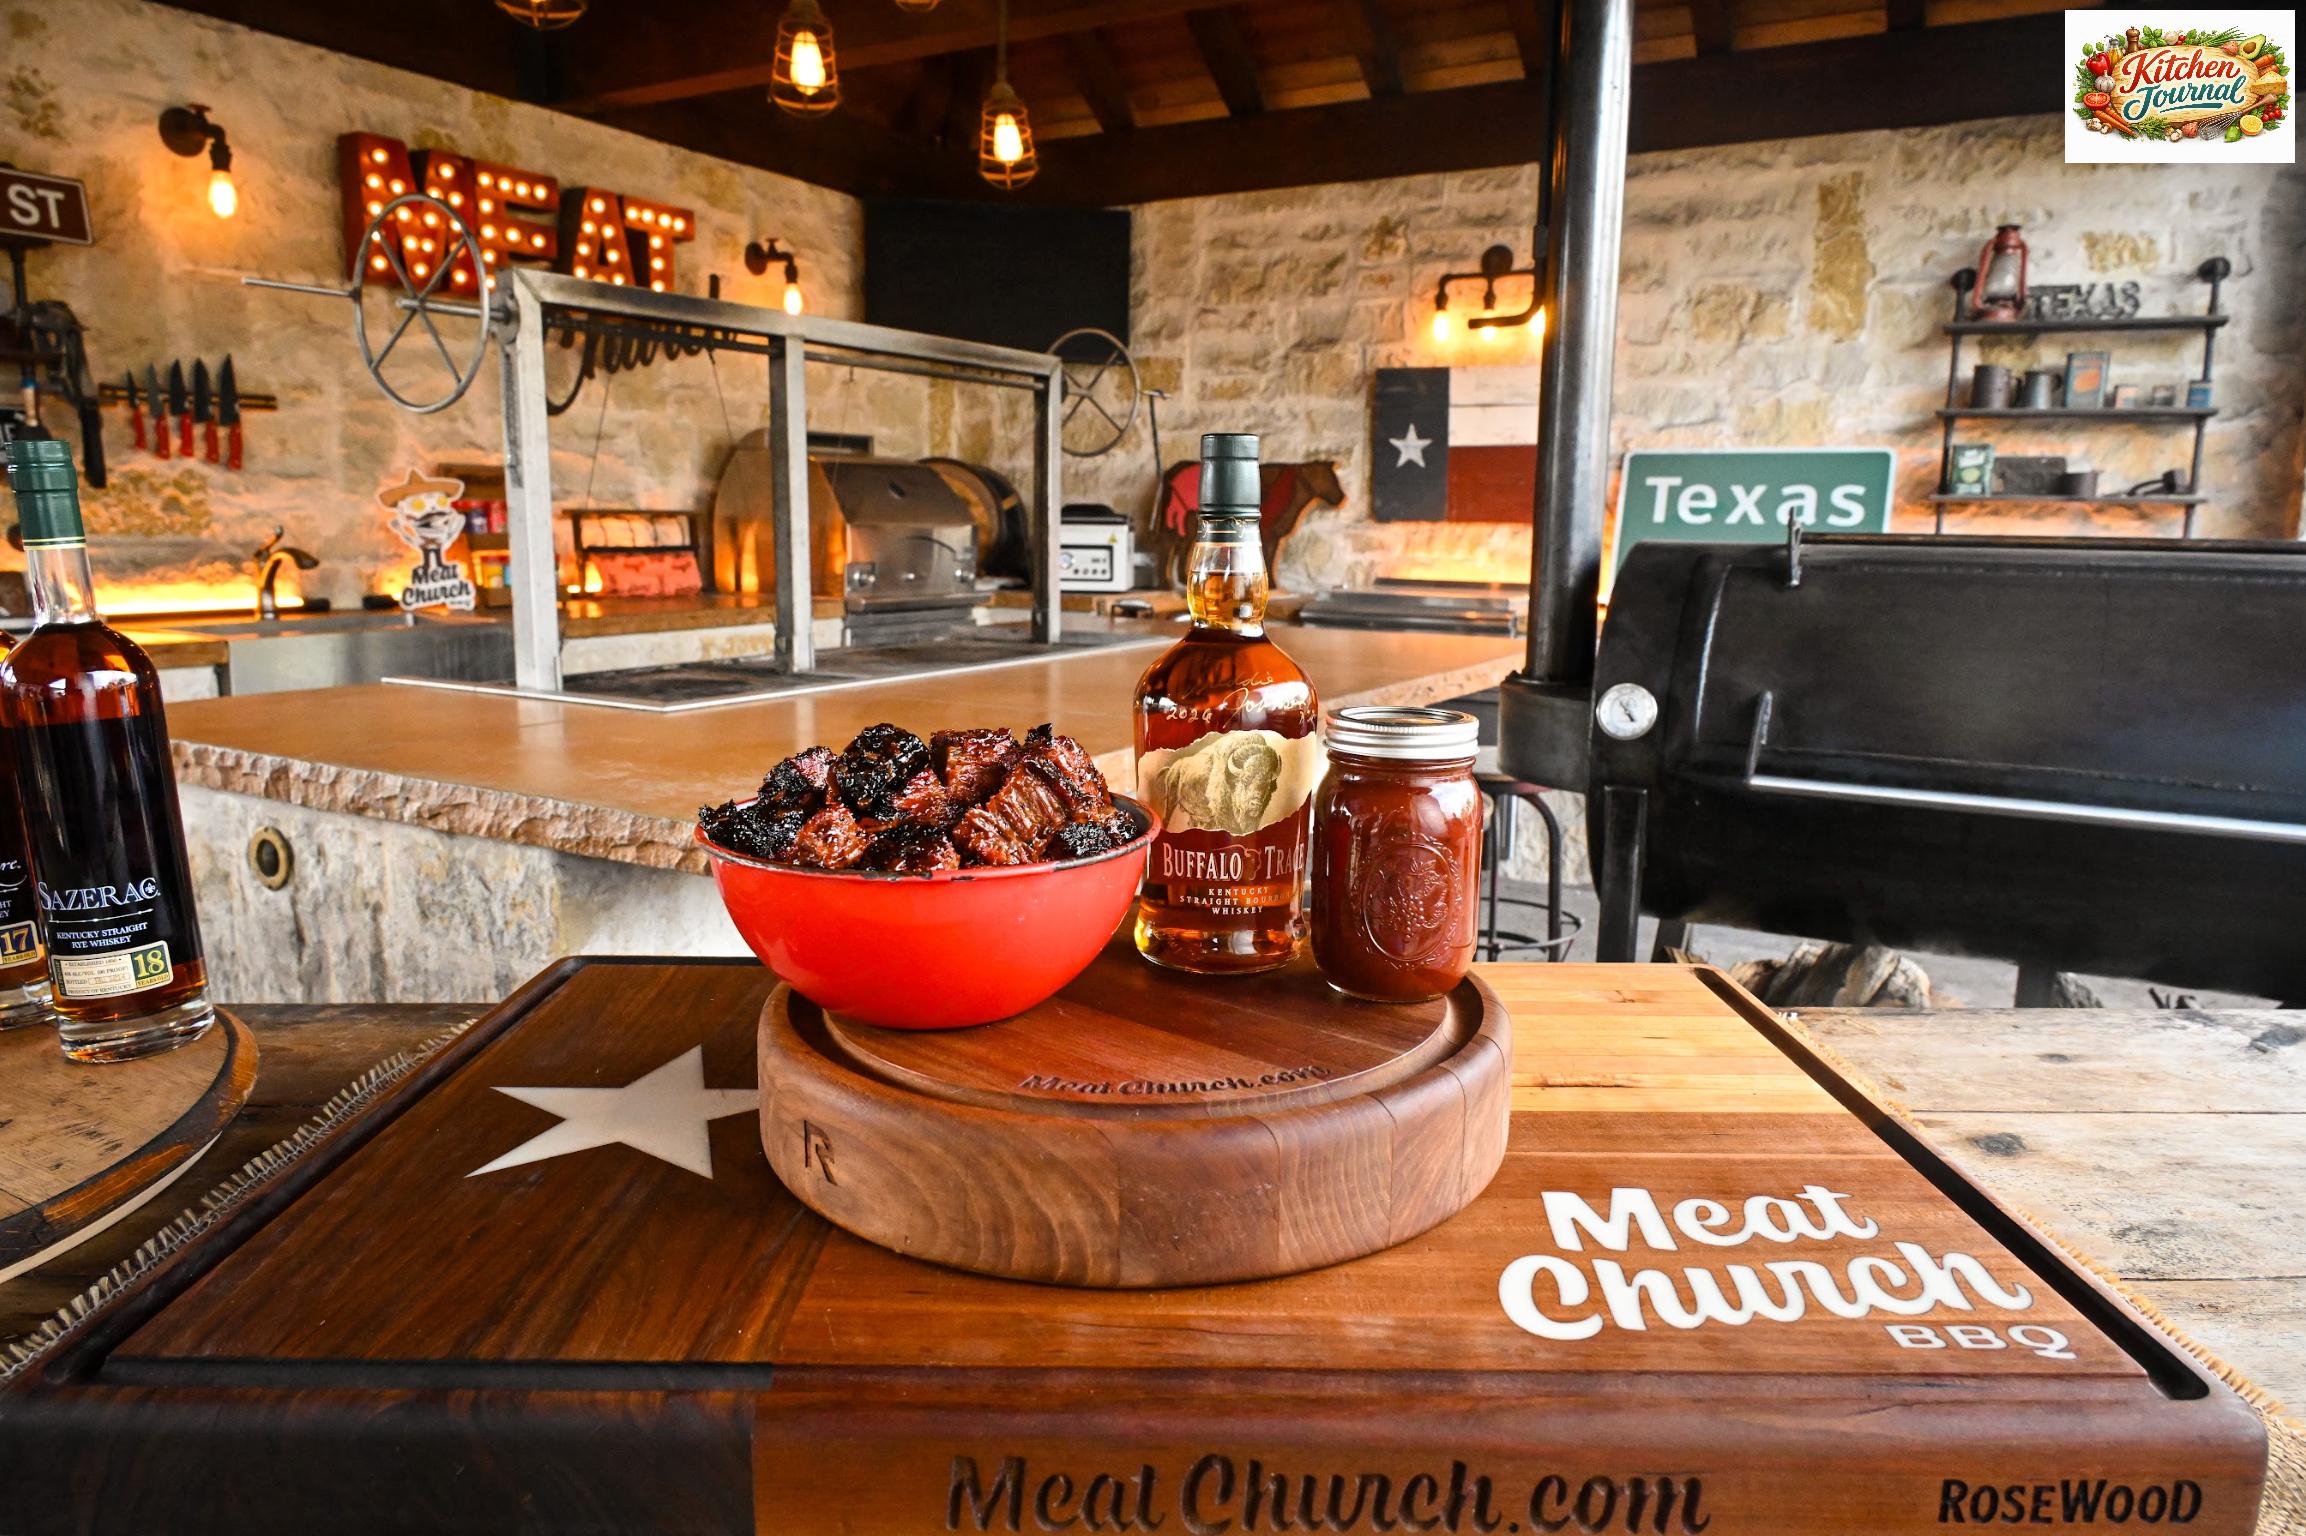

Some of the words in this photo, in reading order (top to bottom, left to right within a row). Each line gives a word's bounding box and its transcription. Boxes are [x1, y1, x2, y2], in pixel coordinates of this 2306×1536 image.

[7, 183, 65, 228] ST
[338, 131, 695, 298] MEAT
[2028, 281, 2140, 320] TEXAS
[1645, 476, 1867, 527] Texas
[402, 581, 471, 606] Church
[1163, 842, 1242, 881] BUFFALO
[38, 877, 157, 910] SAZERAC
[1180, 896, 1239, 905] STRAIGHT
[1208, 887, 1269, 897] KENTUCKY
[1212, 906, 1263, 915] WHISKEY
[1, 928, 29, 954] 17
[57, 930, 99, 940] KENTUCKY
[102, 922, 148, 937] STRAIGHT
[72, 941, 88, 949] RYE
[89, 935, 132, 947] WHISKEY
[134, 949, 166, 978] 18
[1541, 1184, 1880, 1252] Meat
[1498, 1241, 2034, 1341] Church
[1883, 1324, 2078, 1360] BBQ
